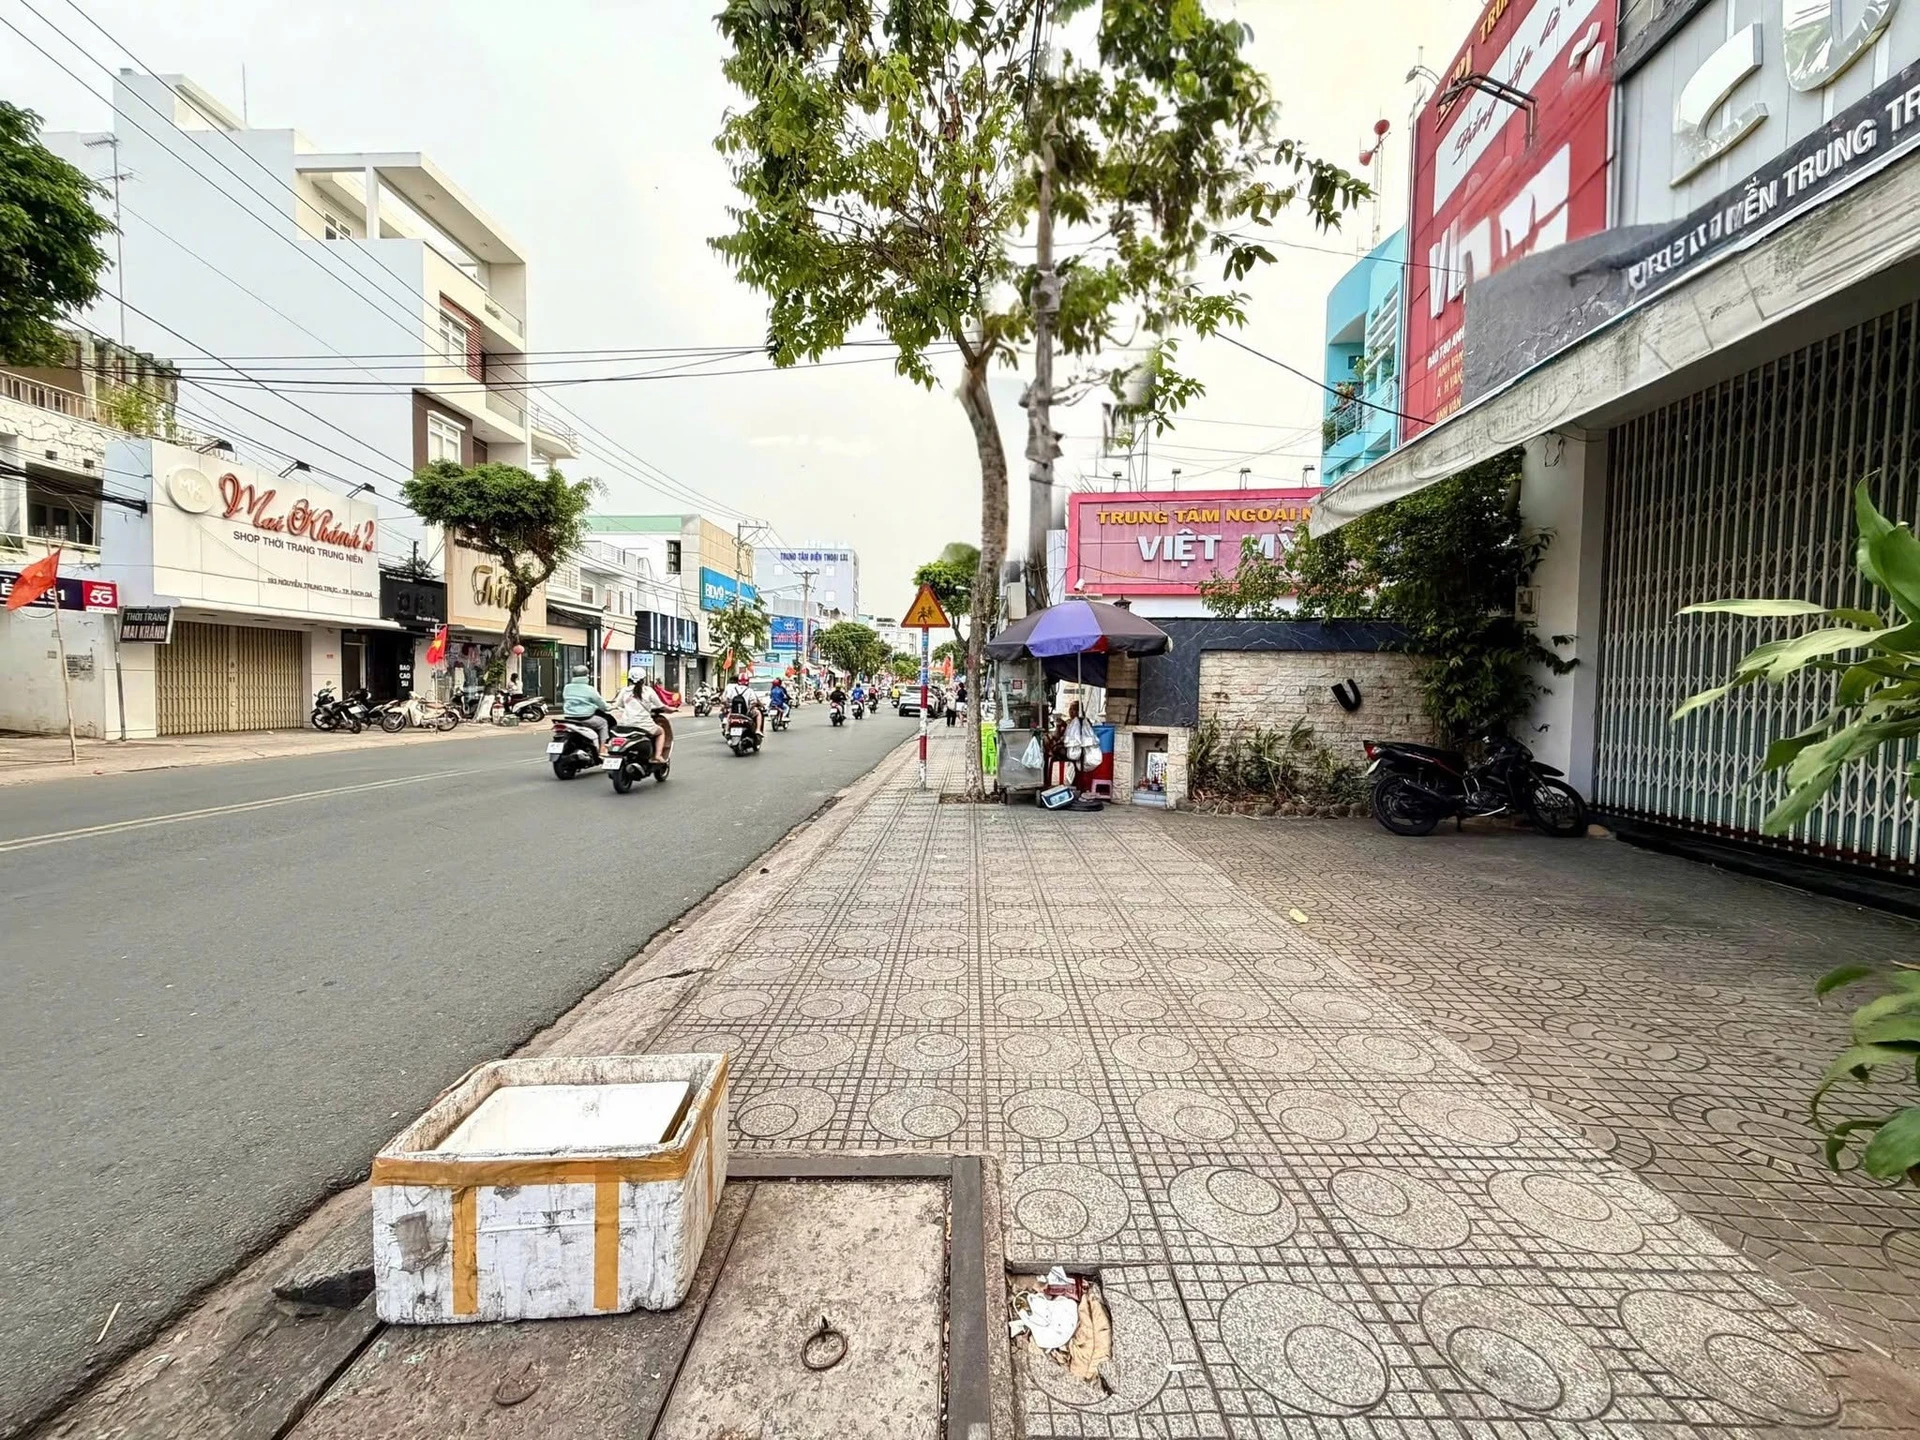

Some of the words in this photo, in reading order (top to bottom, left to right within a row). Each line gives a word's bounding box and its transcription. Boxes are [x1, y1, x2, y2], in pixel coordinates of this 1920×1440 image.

[1783, 119, 1877, 197] TRUNG
[219, 473, 284, 532] Mai
[1098, 510, 1169, 525] TRUNG
[1174, 507, 1220, 523] TÂM
[233, 530, 260, 543] SHOP
[286, 541, 315, 555] TRANG
[317, 547, 344, 561] TRUNG
[1137, 528, 1222, 568] VIỆT
[90, 589, 114, 605] 5G
[144, 612, 168, 621] TRANG
[122, 625, 138, 639] MAI
